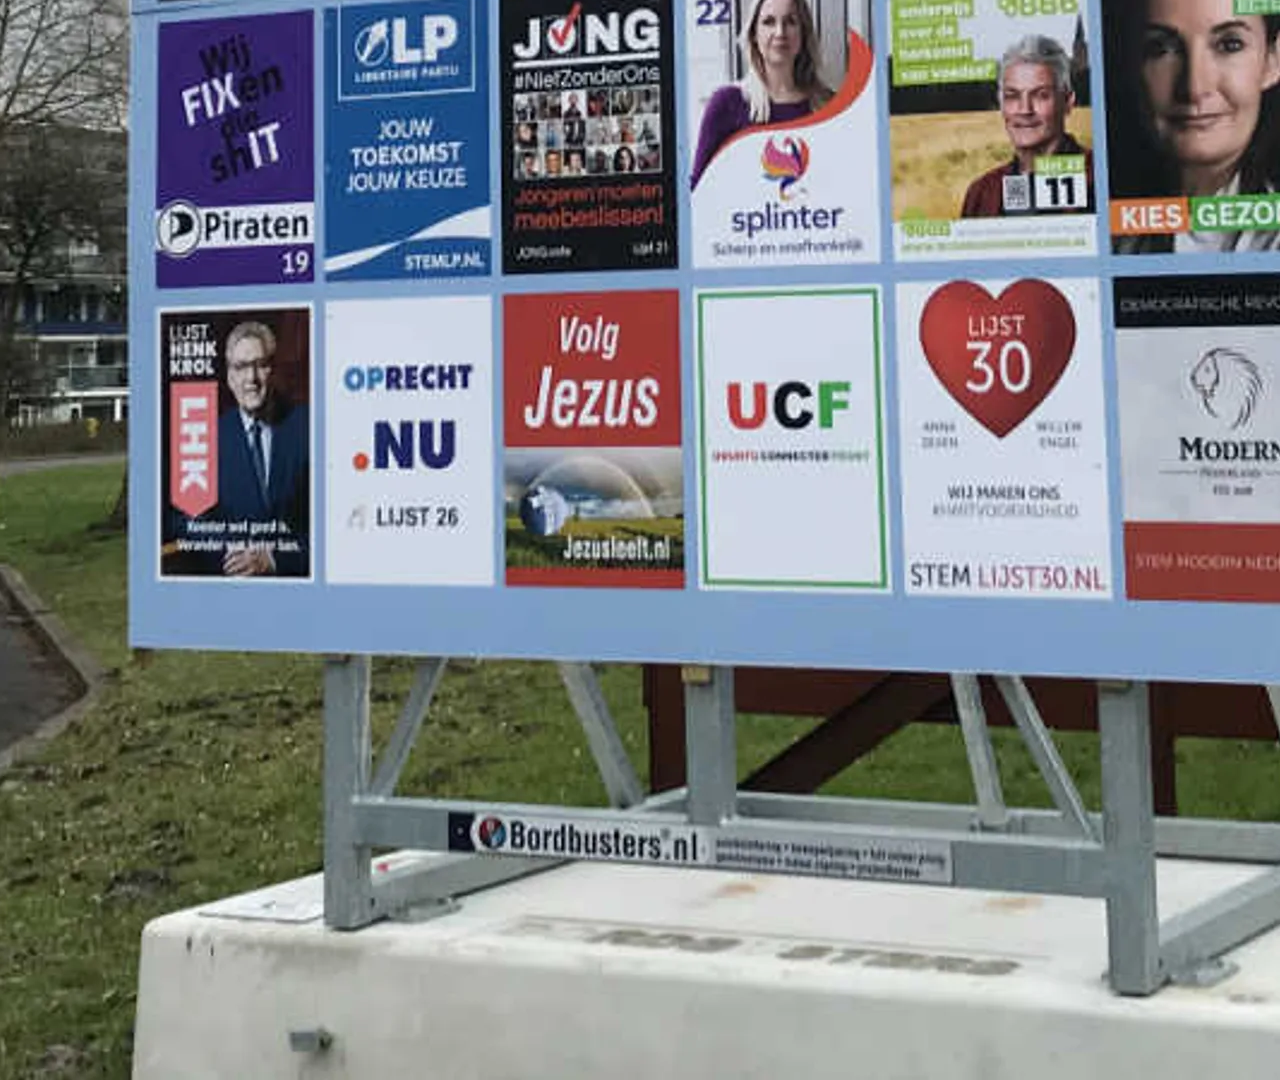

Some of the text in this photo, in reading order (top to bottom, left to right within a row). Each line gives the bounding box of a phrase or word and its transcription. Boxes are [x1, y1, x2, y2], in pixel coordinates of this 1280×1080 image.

[392, 14, 458, 64] LP
[513, 6, 660, 59] JONG
[200, 33, 251, 77] Wij
[514, 65, 660, 89] #NietZonderOns
[378, 118, 433, 140] JOUW
[350, 142, 464, 168] TOEKOMST
[347, 167, 467, 193] JOUW KEUZE
[1045, 177, 1076, 205] 11
[514, 181, 663, 206] Jongeren moeten
[205, 211, 308, 242] Piraten
[514, 204, 663, 230] meebeslissen!
[731, 202, 845, 238] splinter
[1120, 204, 1183, 230] KIES
[281, 250, 309, 274] 19
[404, 252, 484, 270] STEMLP.NL
[170, 324, 209, 340] LIJST
[560, 315, 620, 360] Volg
[968, 316, 1024, 336] LIJST
[170, 341, 218, 357] HENK
[170, 359, 215, 376] KROL
[344, 364, 473, 391] OPRECHT
[966, 341, 1032, 394] 30
[524, 365, 659, 429] Jezus
[727, 381, 851, 430] UCF
[180, 396, 209, 494] LHK
[353, 420, 456, 470] .NU
[948, 485, 1061, 499] WIJ MAKEN ONS
[376, 506, 459, 527] LIJST 26
[563, 536, 670, 561] Jezusleeft.nl
[1135, 552, 1173, 569] STEM
[1177, 553, 1242, 570] MODERN
[911, 563, 1107, 591] STEM LIJST30.NL
